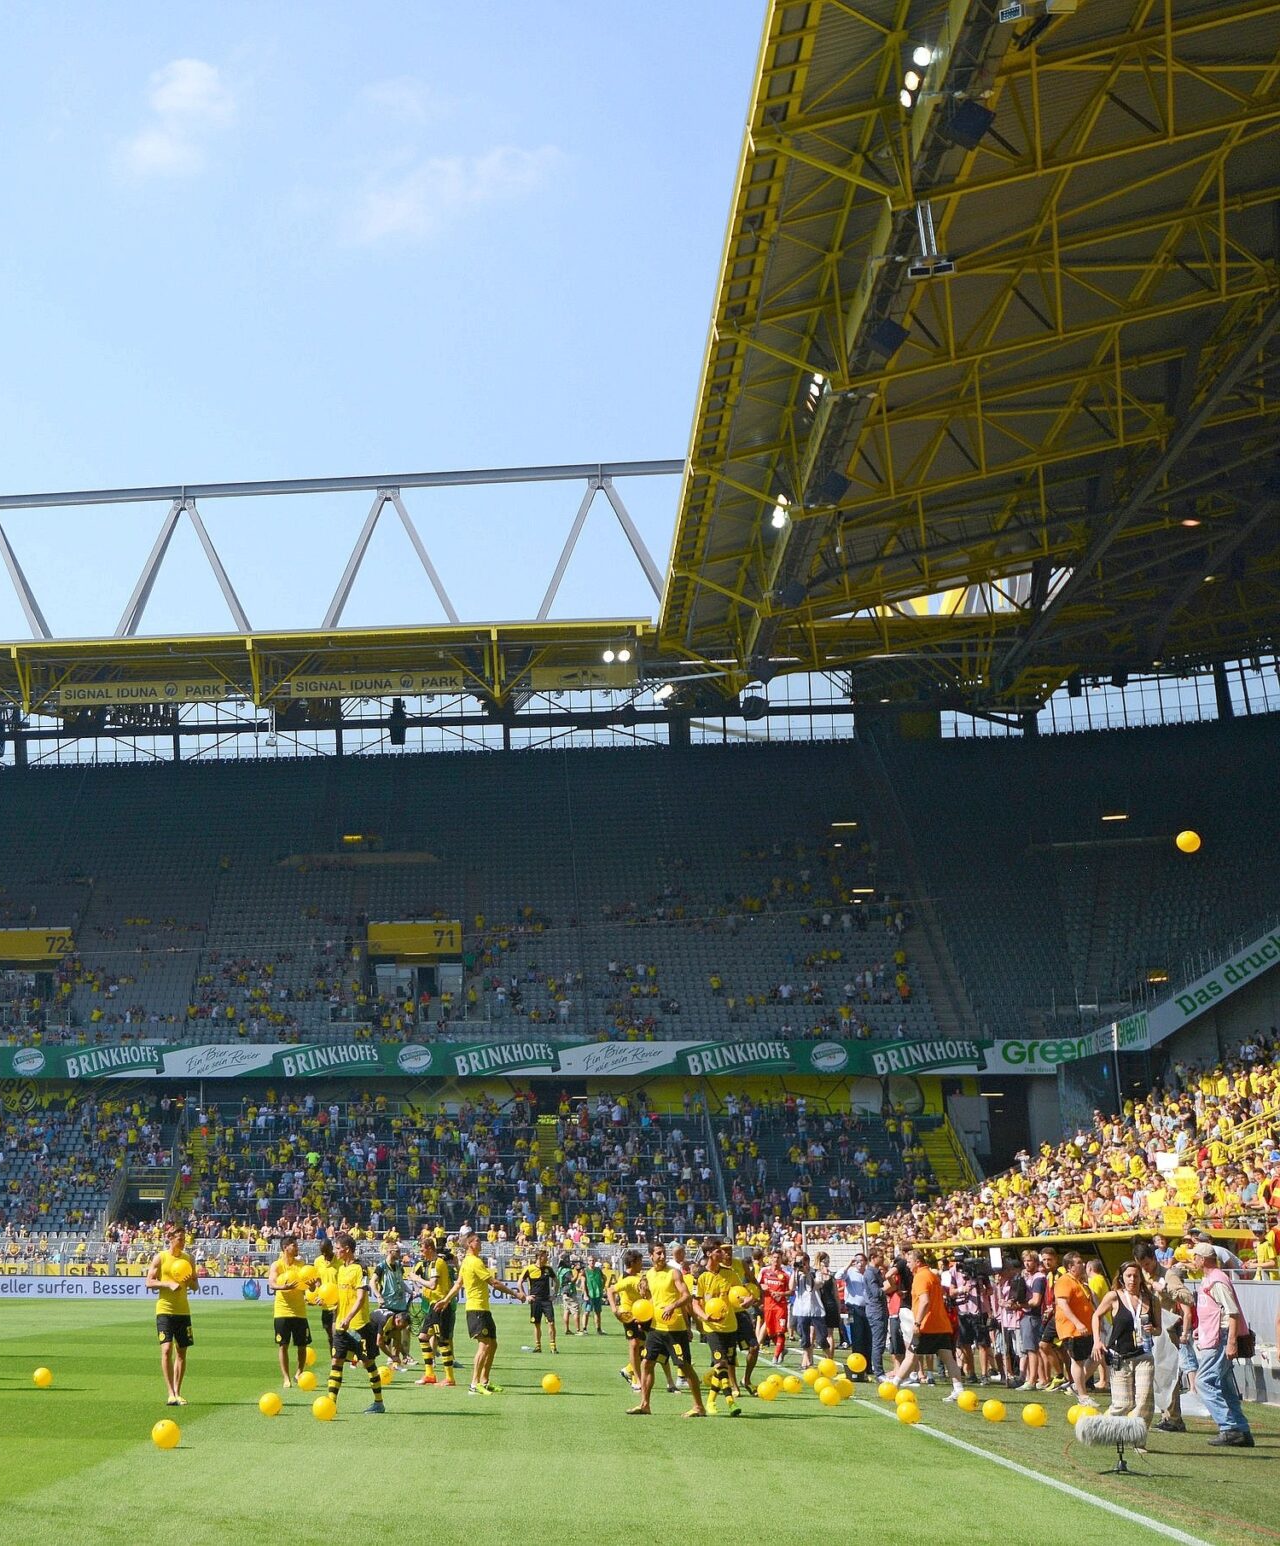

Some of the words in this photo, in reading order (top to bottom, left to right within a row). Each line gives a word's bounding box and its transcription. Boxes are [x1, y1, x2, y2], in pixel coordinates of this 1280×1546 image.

[64, 688, 113, 700] SIGNAL
[117, 687, 157, 698] IDUNA
[185, 684, 220, 696] PARK
[295, 681, 346, 693] SIGNAL
[351, 679, 393, 690] IDUNA
[422, 676, 459, 687] PARK
[434, 929, 454, 947] 71
[1175, 980, 1223, 1016] Das
[185, 1055, 202, 1074] Ein
[201, 1047, 228, 1060] Bier
[196, 1065, 210, 1075] wie
[211, 1057, 227, 1068] sein
[227, 1049, 261, 1062] Revier
[583, 1053, 600, 1071] Ein
[599, 1044, 629, 1058] Bier
[595, 1062, 609, 1073] wie
[610, 1055, 628, 1066] sein
[628, 1046, 664, 1060] Revier
[37, 1276, 88, 1294] surfen.
[93, 1280, 141, 1295] Besser
